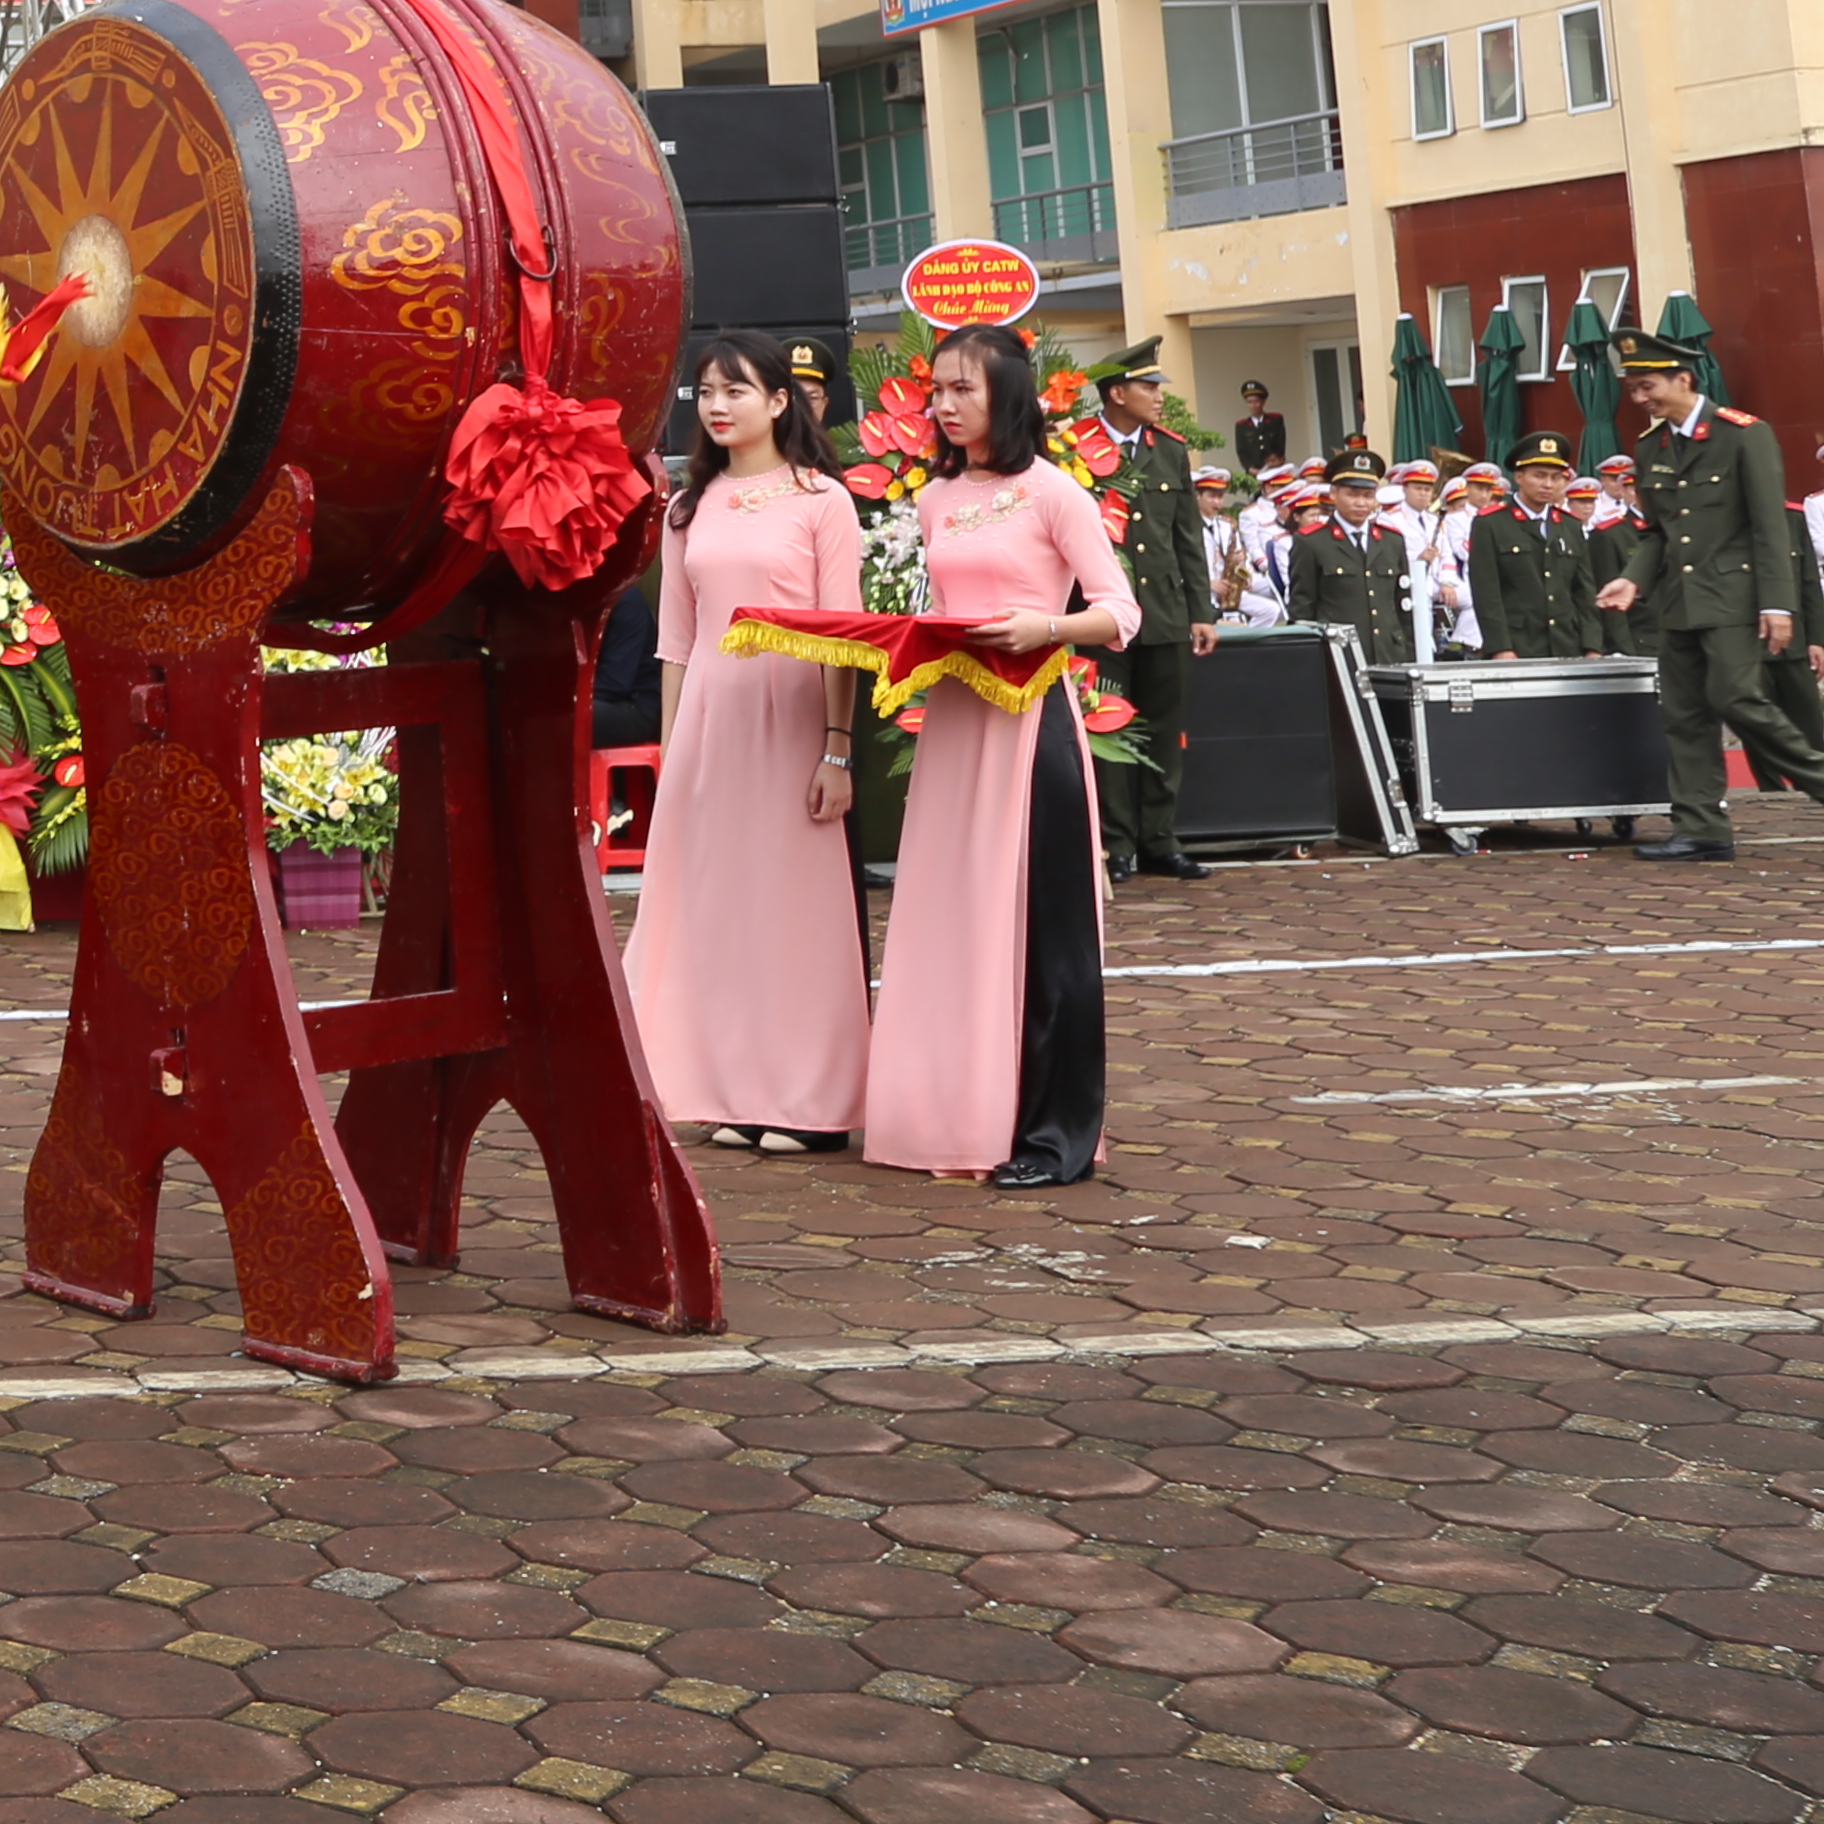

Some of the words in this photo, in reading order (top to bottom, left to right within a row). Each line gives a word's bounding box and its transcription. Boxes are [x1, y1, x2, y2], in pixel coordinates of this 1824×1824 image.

[923, 259, 959, 275] ĐẢNG
[961, 258, 980, 274] ỦY
[982, 259, 1020, 273] CATW
[966, 280, 983, 297] BỘ
[983, 280, 1013, 293] CÔNG
[1014, 280, 1031, 292] AN
[933, 301, 967, 315] Chúc
[967, 299, 1010, 315] Mừng
